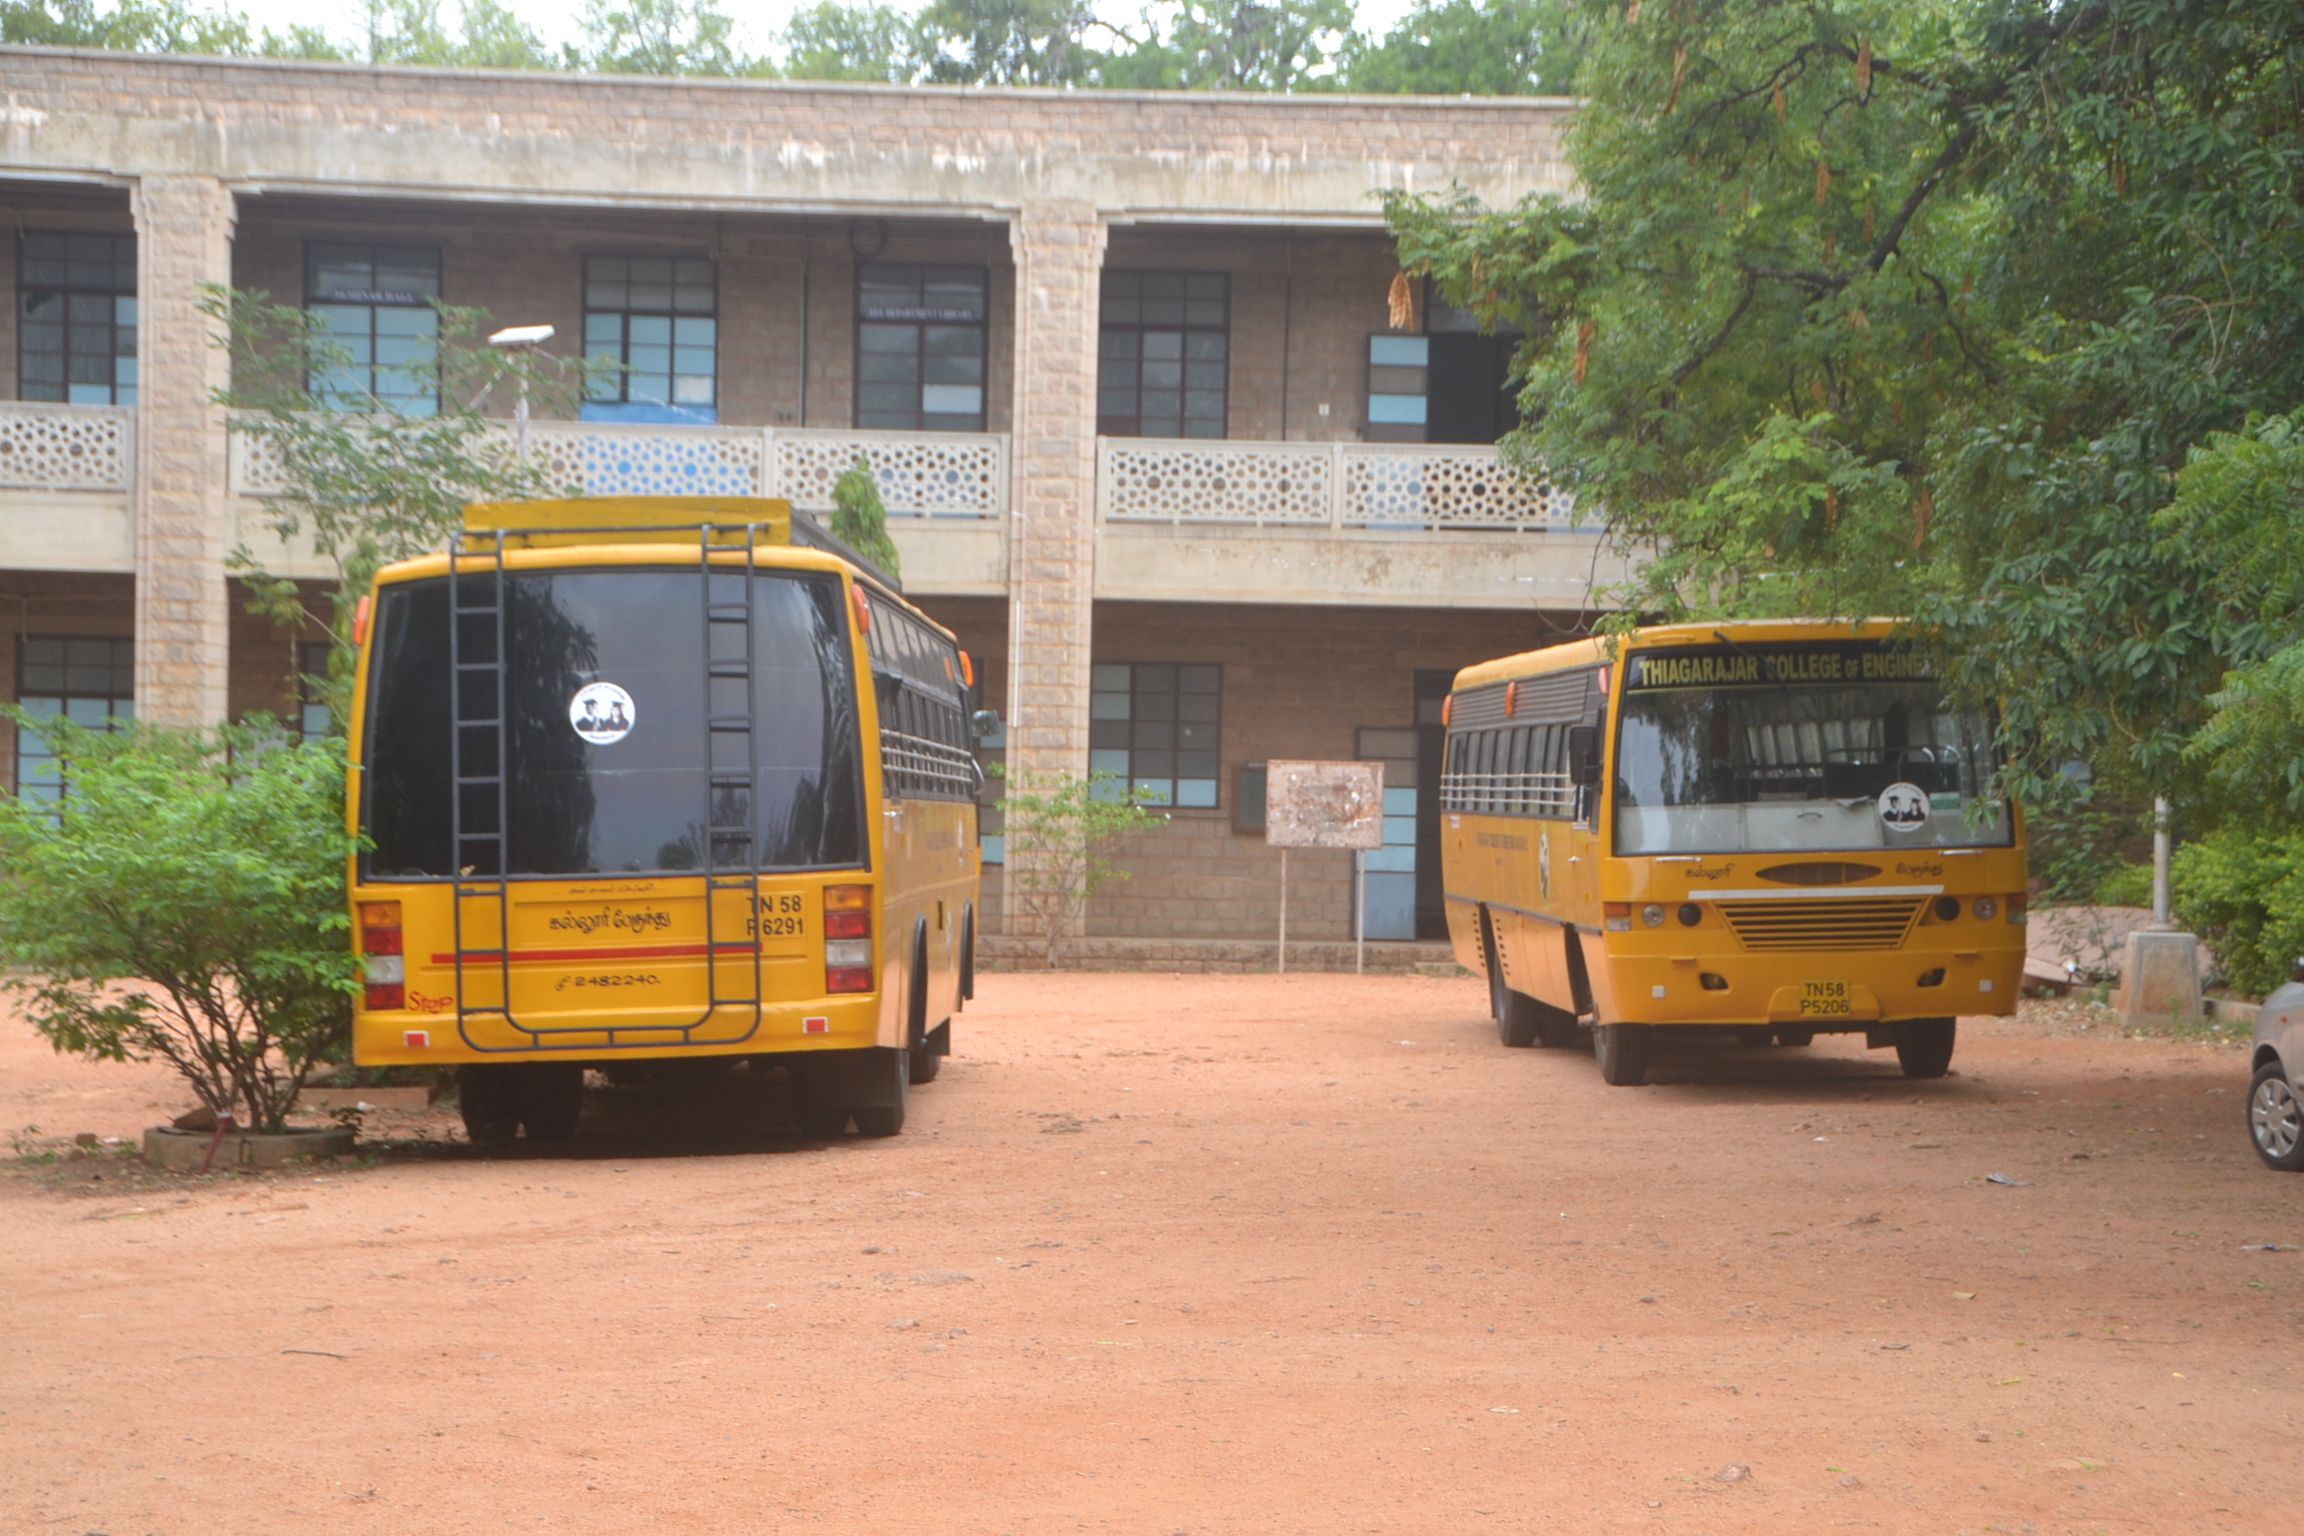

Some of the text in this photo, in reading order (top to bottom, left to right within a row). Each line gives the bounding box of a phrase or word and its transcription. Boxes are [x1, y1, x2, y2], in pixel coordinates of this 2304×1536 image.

[1638, 656, 1758, 686] THIAGARAJAR
[1766, 654, 1841, 680] COLLEGE
[780, 895, 802, 913] 58
[1800, 999, 1849, 1014] P5206
